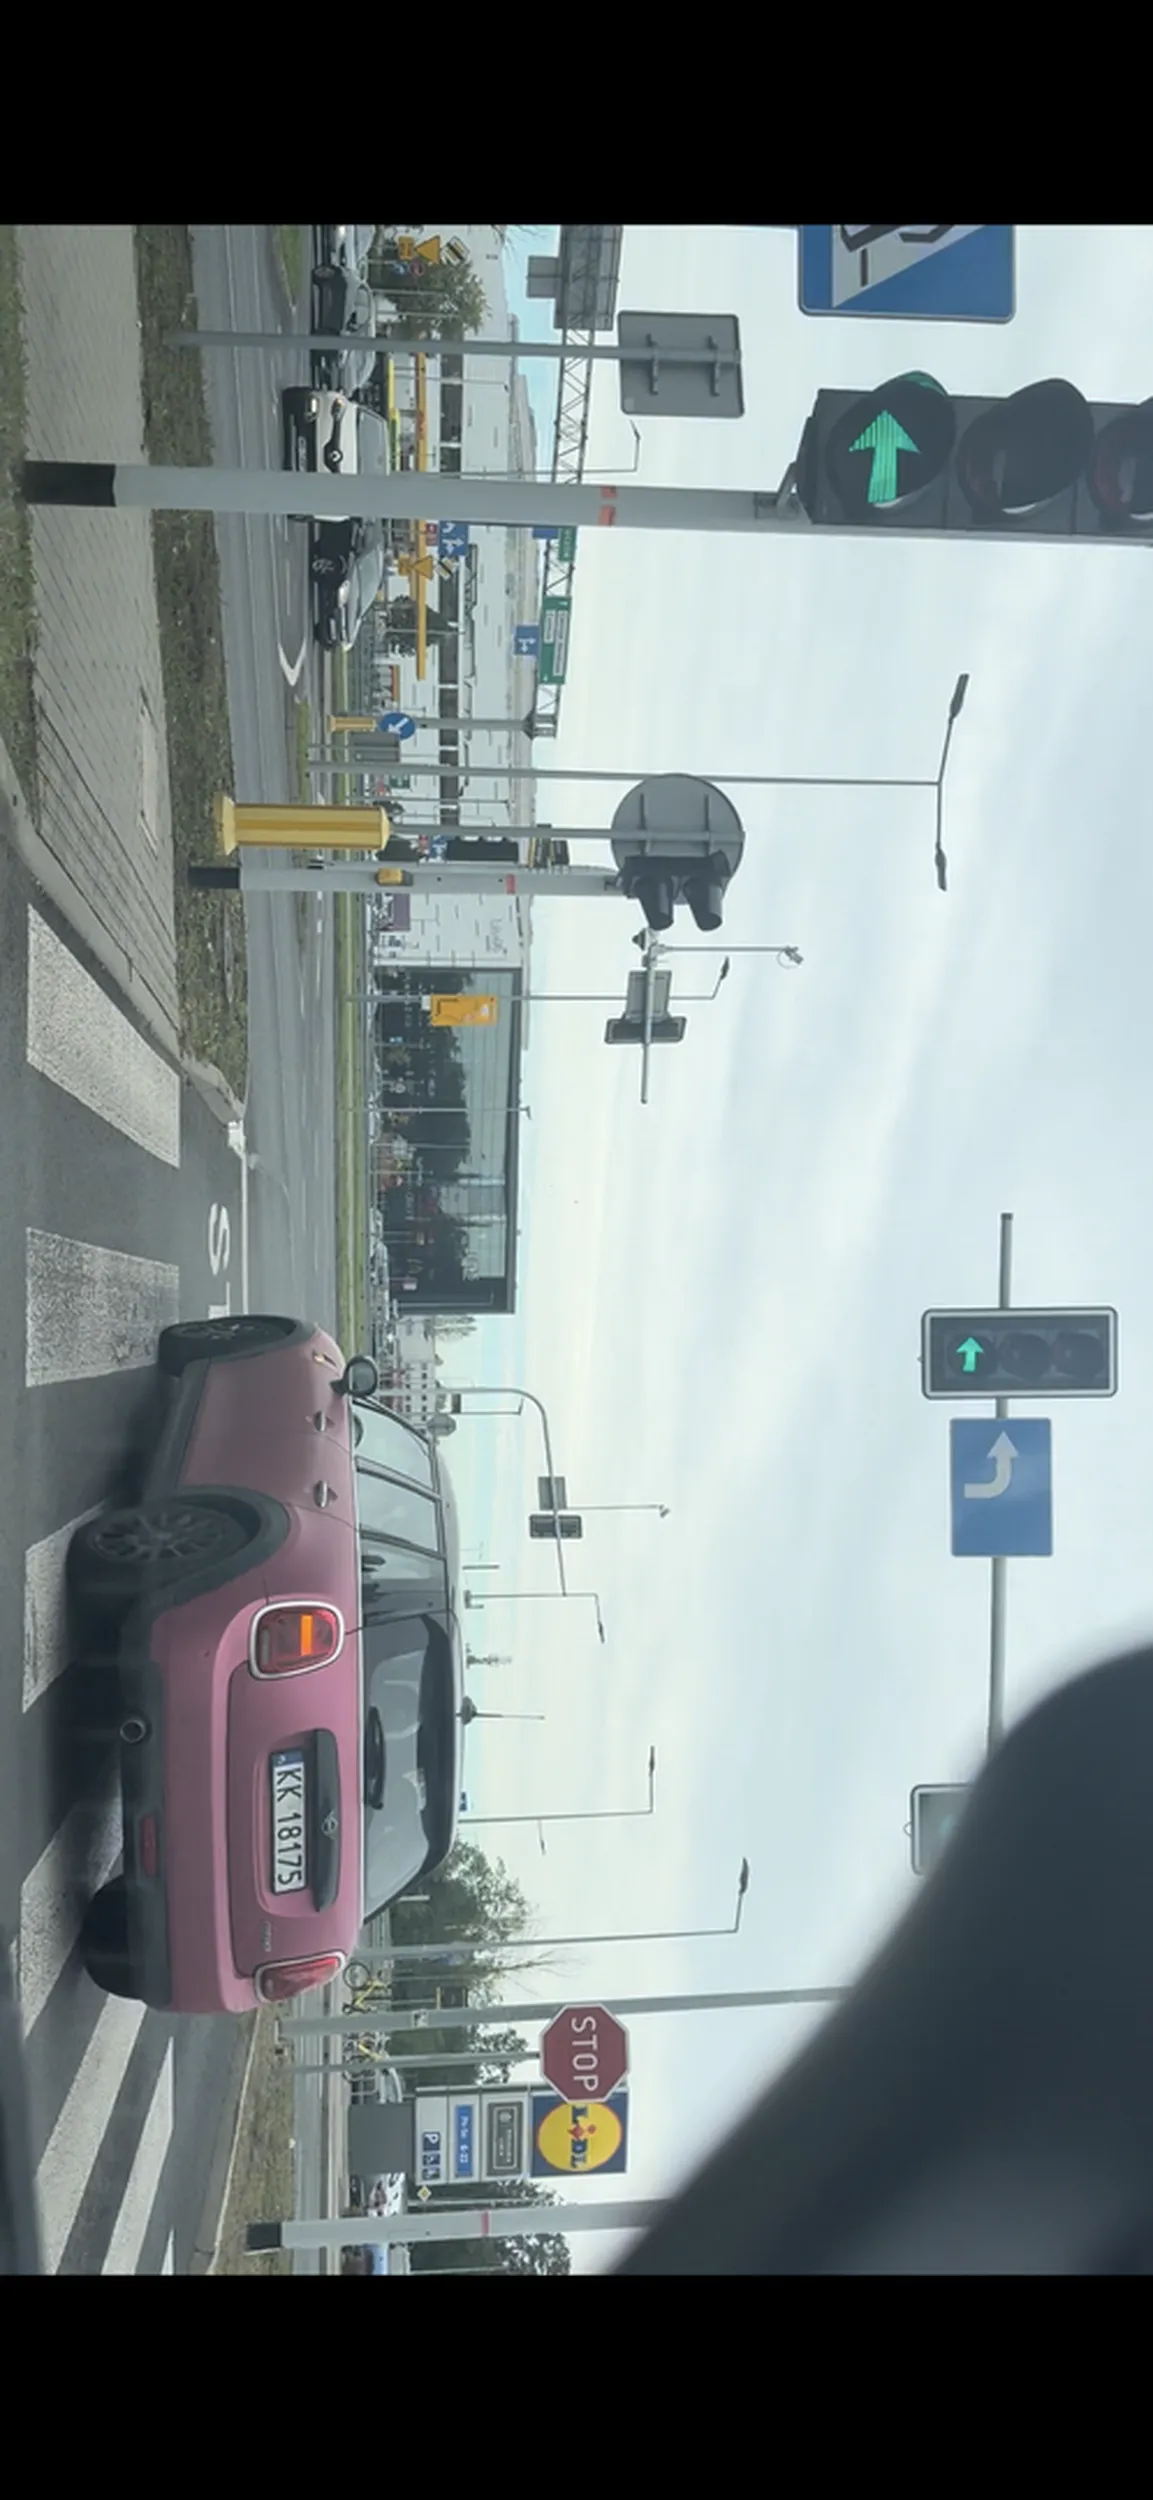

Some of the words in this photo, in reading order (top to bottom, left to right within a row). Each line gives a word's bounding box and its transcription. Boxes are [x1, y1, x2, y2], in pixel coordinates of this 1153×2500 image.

[276, 1767, 302, 1803] KK
[276, 1812, 302, 1886] 18175
[570, 2015, 599, 2092] STOP
[424, 2133, 438, 2144] P
